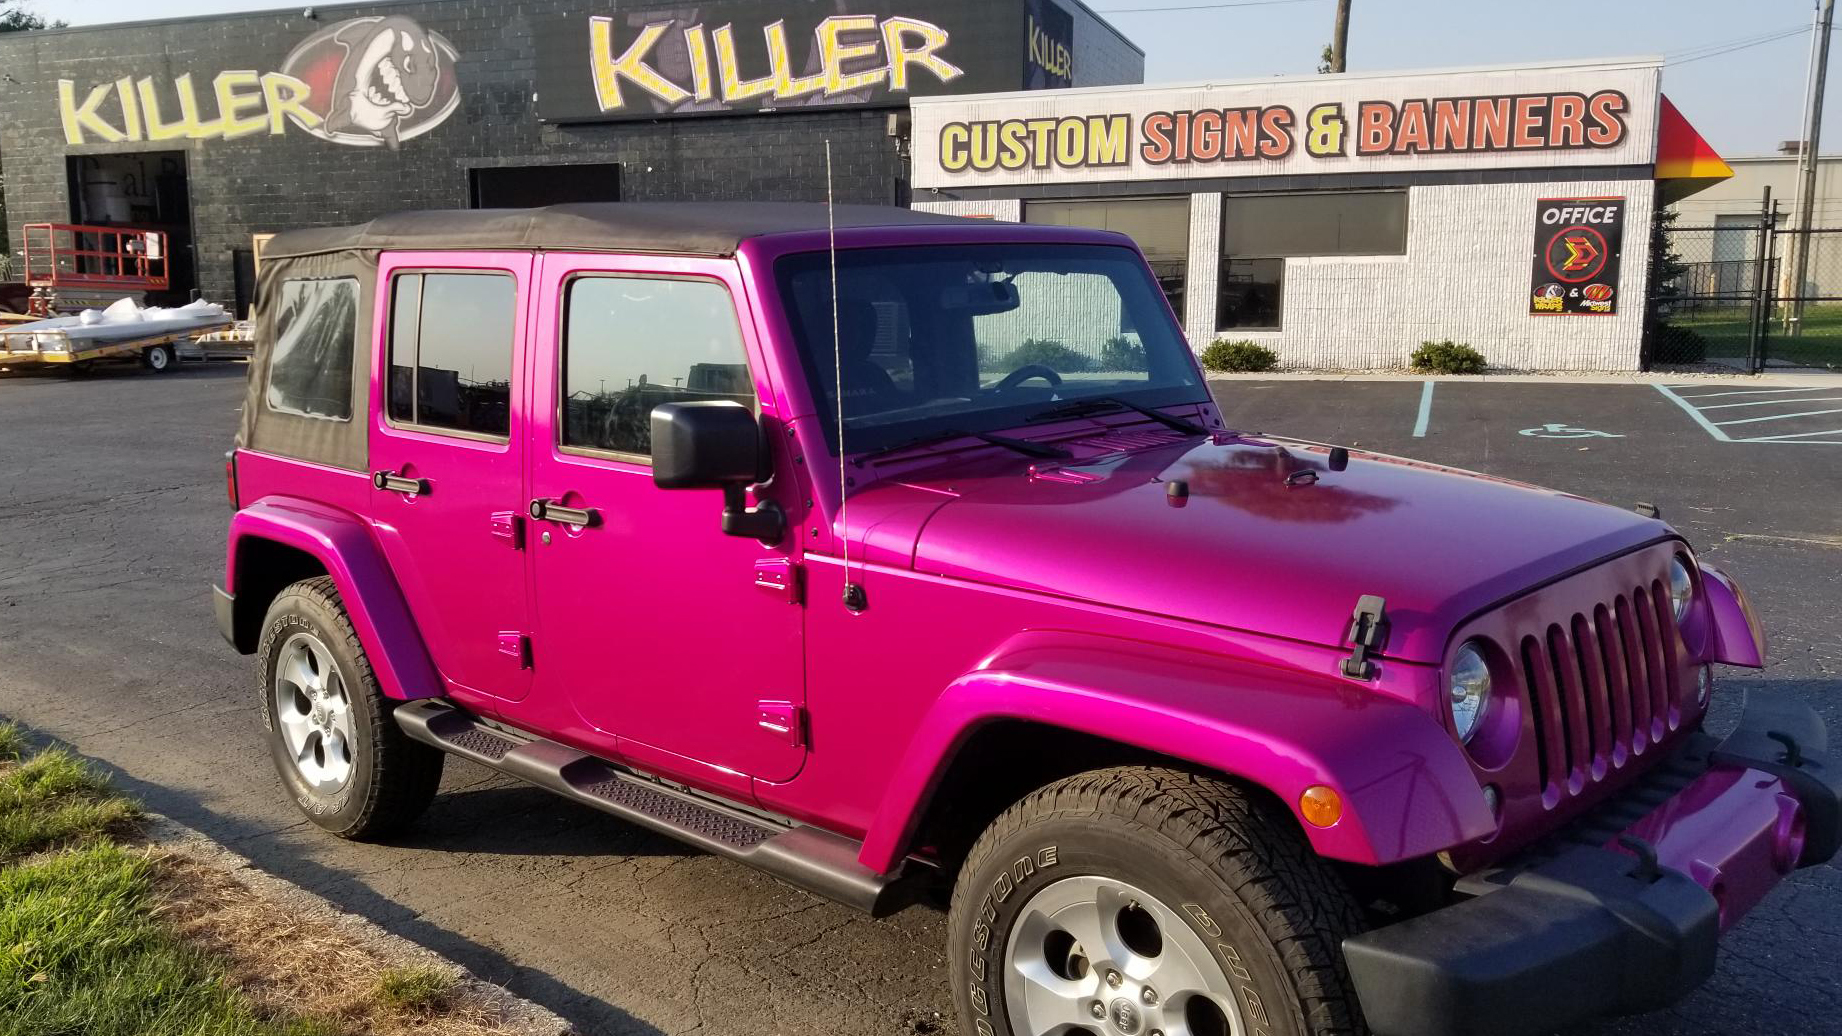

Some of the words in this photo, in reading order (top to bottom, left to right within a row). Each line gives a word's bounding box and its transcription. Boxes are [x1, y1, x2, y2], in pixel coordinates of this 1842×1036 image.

[588, 15, 965, 112] KILLER
[1028, 14, 1072, 80] KILLER
[58, 70, 324, 144] KILLER
[939, 113, 1132, 173] CUSTOM
[1140, 105, 1295, 165] SIGNS
[1305, 102, 1347, 158] &
[1356, 89, 1629, 156] BANNERS
[1542, 206, 1618, 225] OFFICE
[1569, 287, 1579, 297] &
